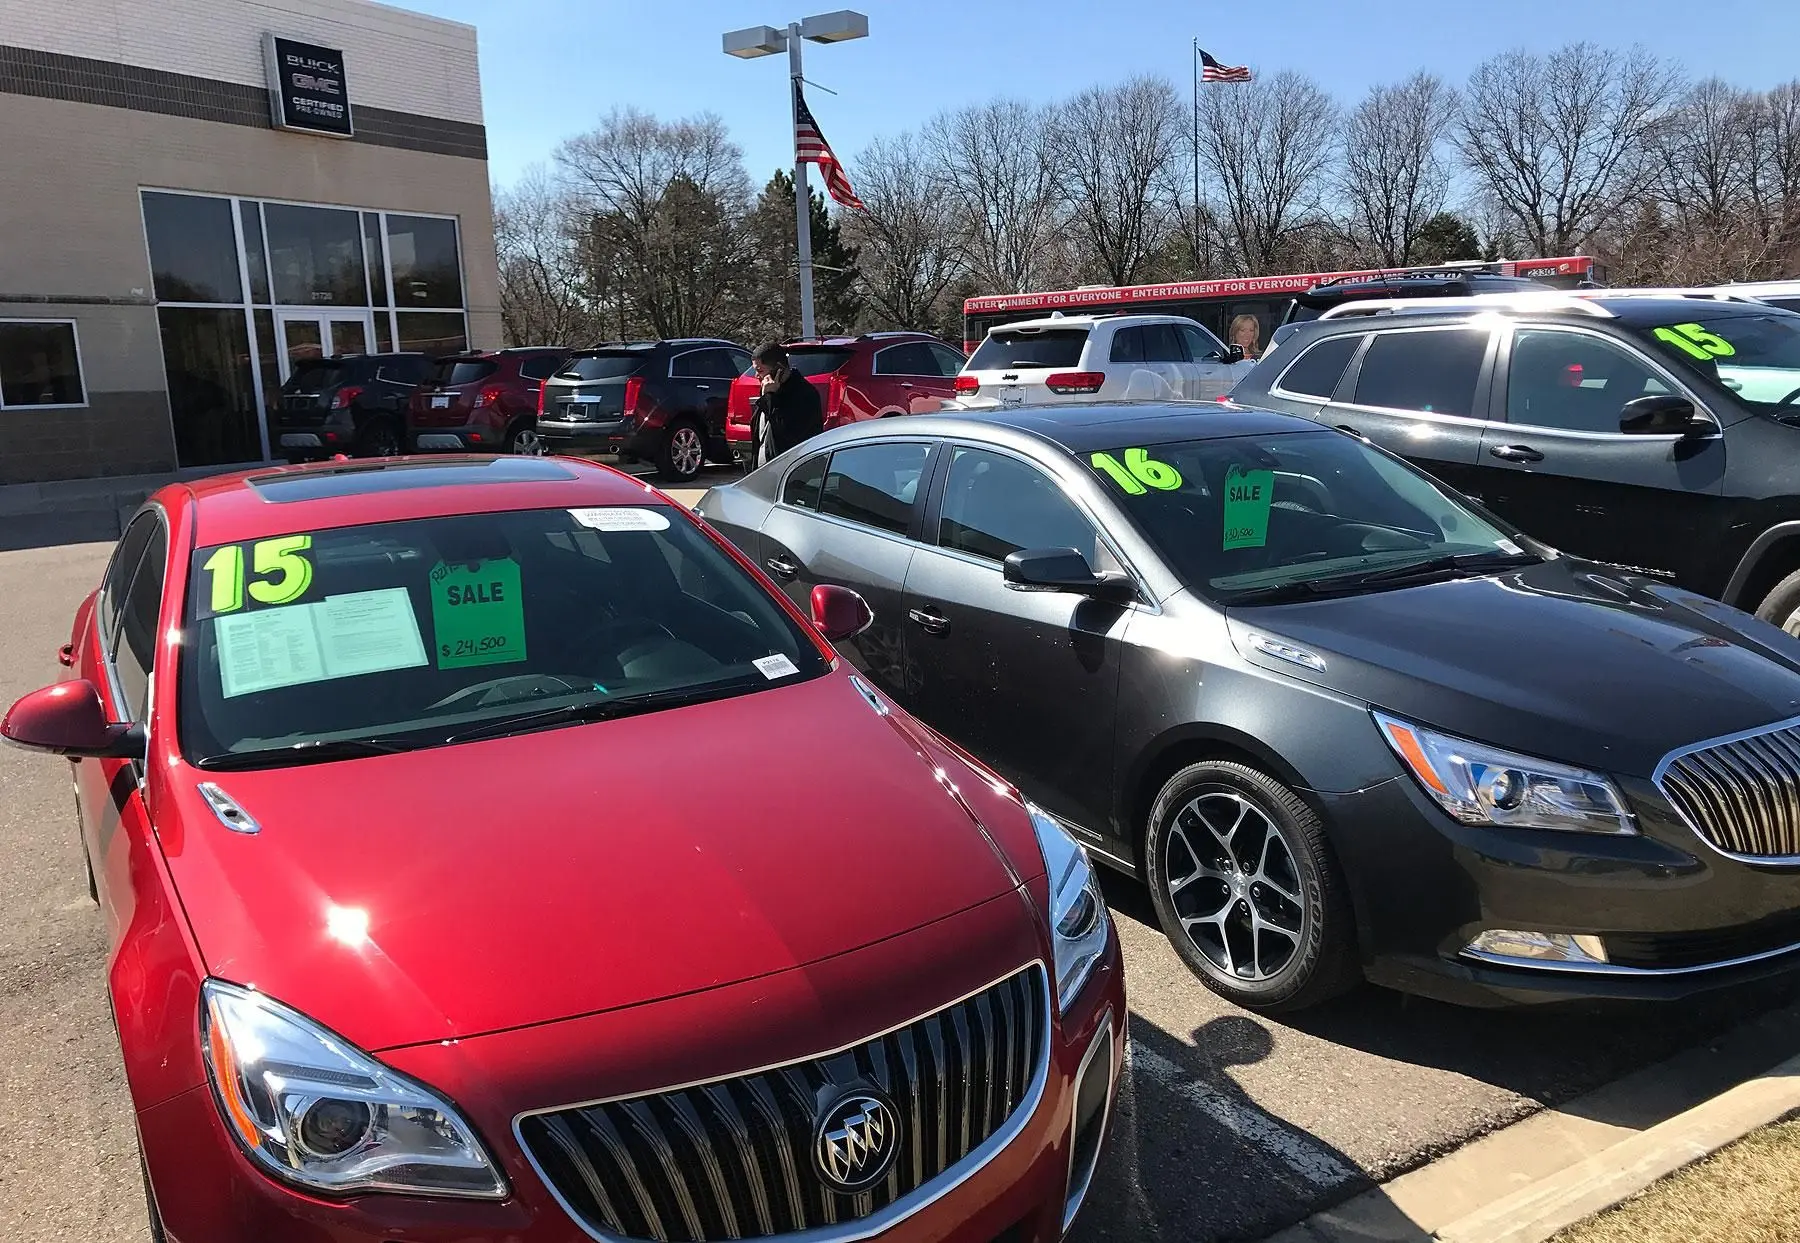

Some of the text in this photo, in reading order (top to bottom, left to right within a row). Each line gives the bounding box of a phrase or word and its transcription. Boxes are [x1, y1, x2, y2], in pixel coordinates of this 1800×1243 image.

[286, 54, 340, 74] BUICK
[292, 73, 340, 95] GMC
[292, 96, 344, 112] CERTIFIED
[295, 105, 343, 119] PRE-OWNED
[966, 296, 1044, 310] ENTERTAINMENT
[1048, 295, 1067, 304] FOR
[1070, 291, 1122, 303] EVERYONE
[1132, 284, 1221, 298] ENTERTAINMENT
[1224, 282, 1246, 292] FOR
[1250, 278, 1309, 290] EVERYONE
[1653, 322, 1736, 361] 15
[1090, 448, 1183, 496] 16
[1229, 485, 1261, 502] SALE
[202, 534, 312, 613] 15
[447, 581, 505, 606] SALE
[455, 636, 507, 656] 24,500
